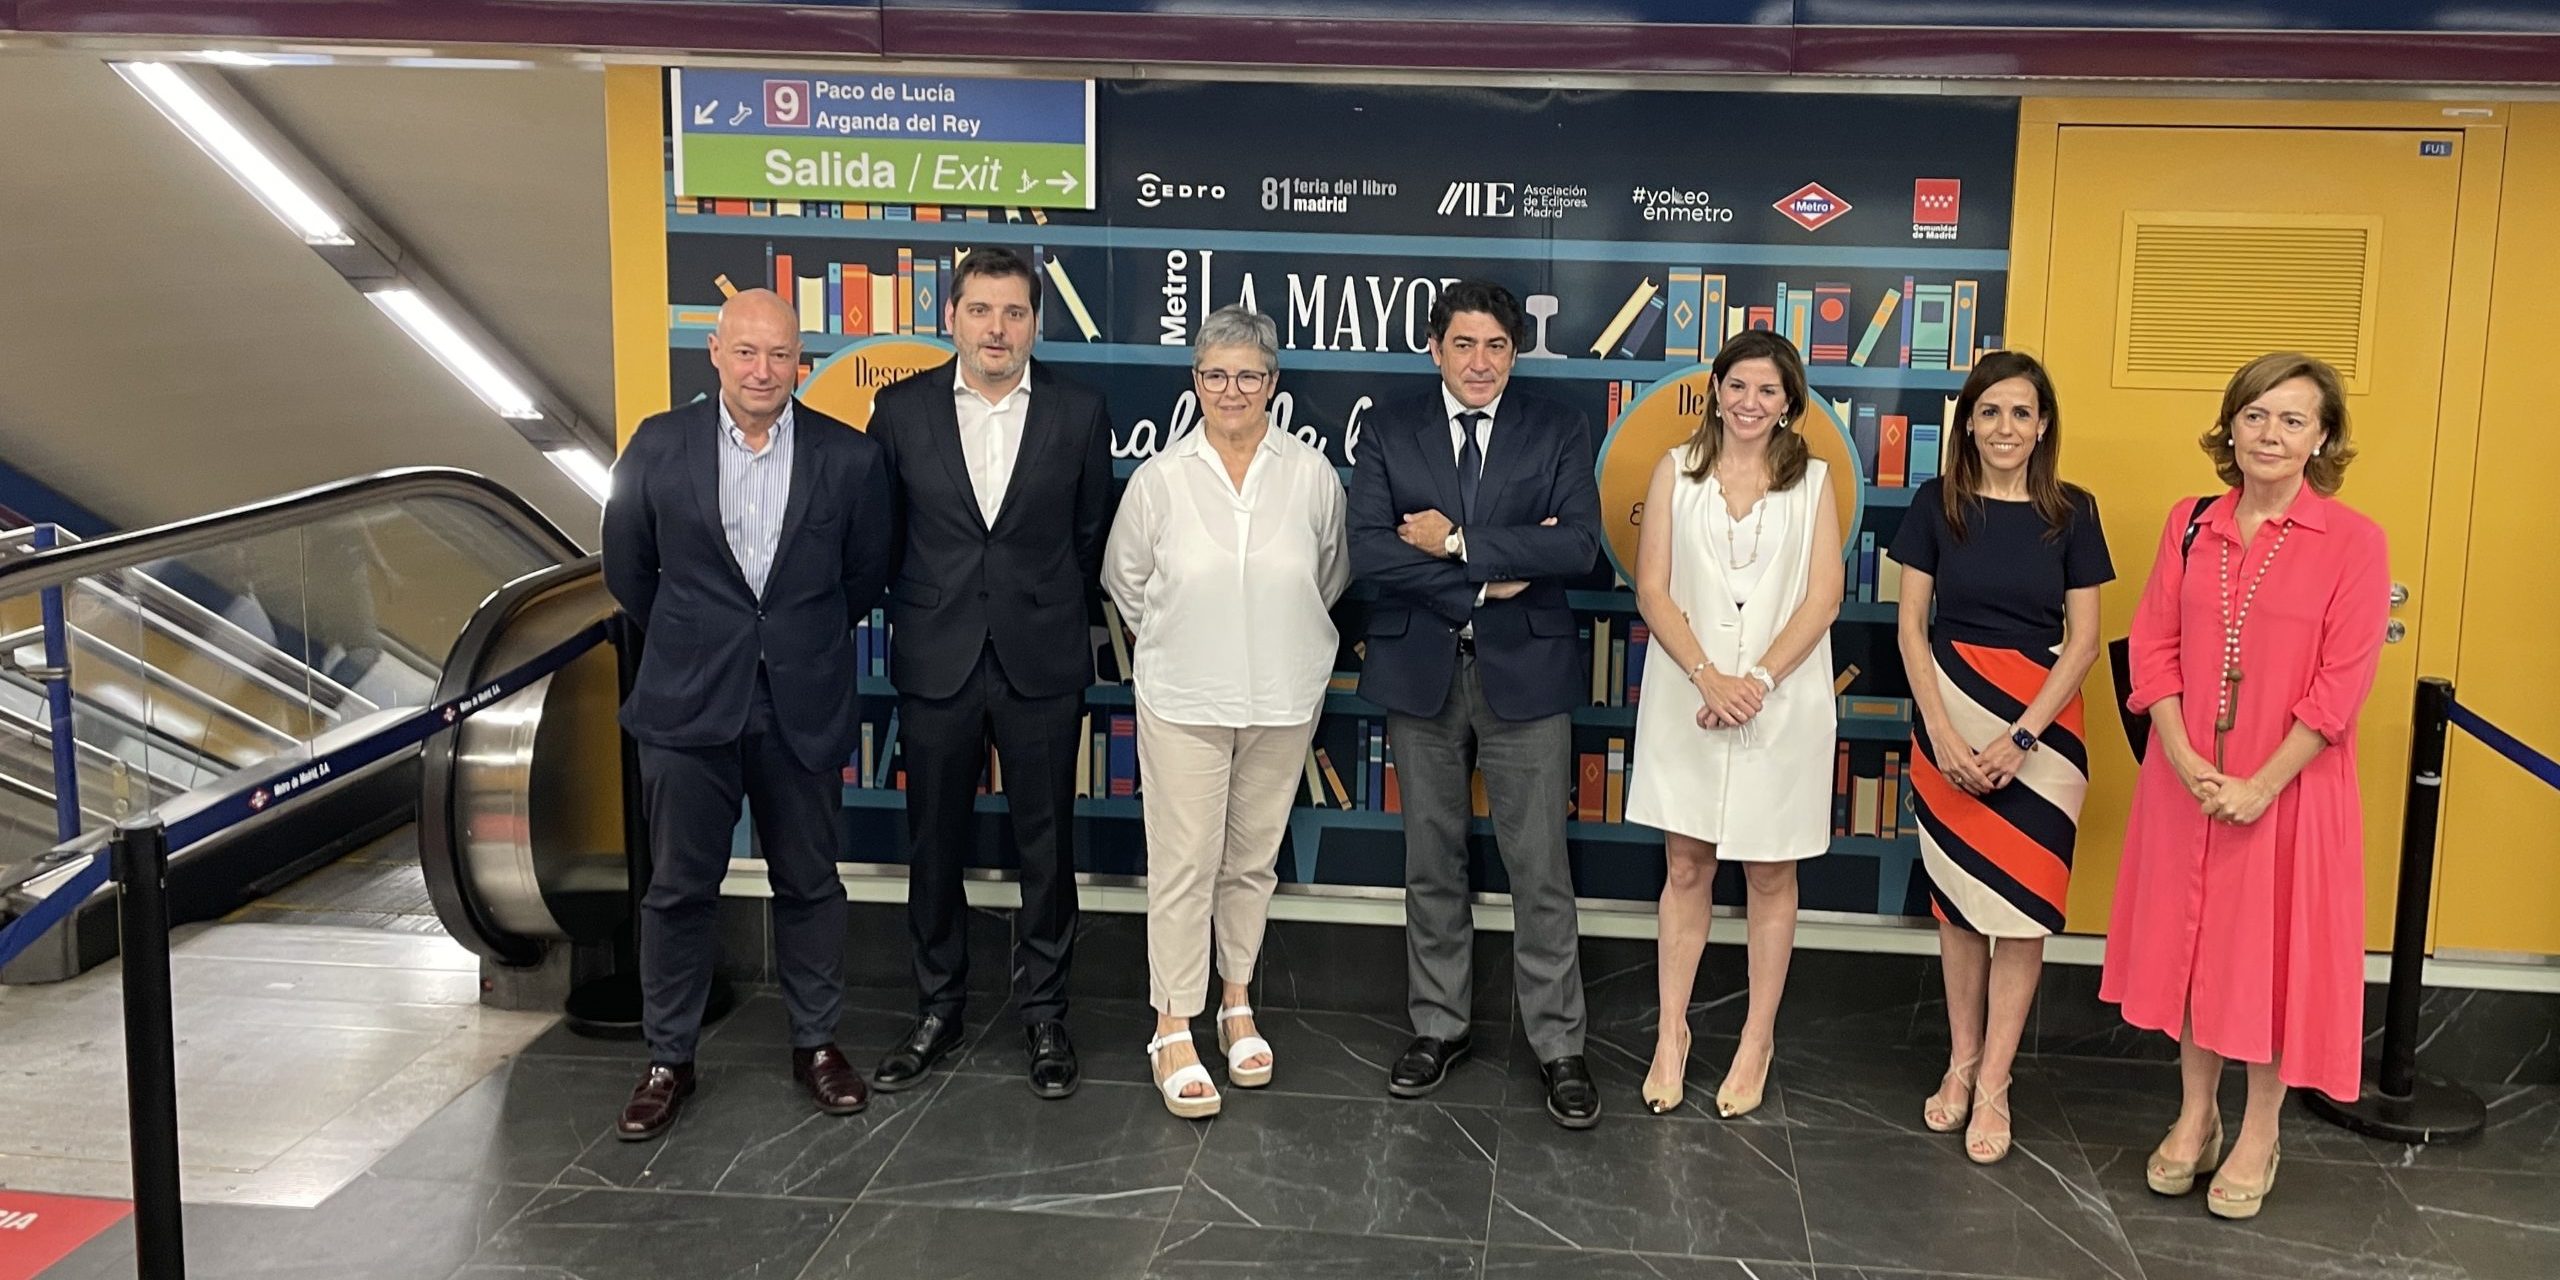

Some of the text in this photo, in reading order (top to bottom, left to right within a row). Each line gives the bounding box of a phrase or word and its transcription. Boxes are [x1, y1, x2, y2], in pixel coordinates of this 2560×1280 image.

[815, 80, 955, 102] Paco de Lucía
[774, 85, 800, 122] 9
[815, 110, 981, 137] Arganda del Rey
[765, 148, 896, 189] Salida
[932, 154, 1002, 192] Exit
[1261, 176, 1291, 211] 81
[1293, 177, 1397, 196] feria del libro
[1523, 184, 1587, 197] Asociación
[1293, 196, 1348, 212] madrid
[1523, 196, 1538, 207] de
[1796, 201, 1829, 213] Metro
[1523, 207, 1563, 218] Madrid
[1643, 205, 1734, 223] enmetro
[1912, 231, 1957, 240] de Madrid
[1160, 249, 1188, 346] Metro
[1285, 273, 1463, 354] MAYO
